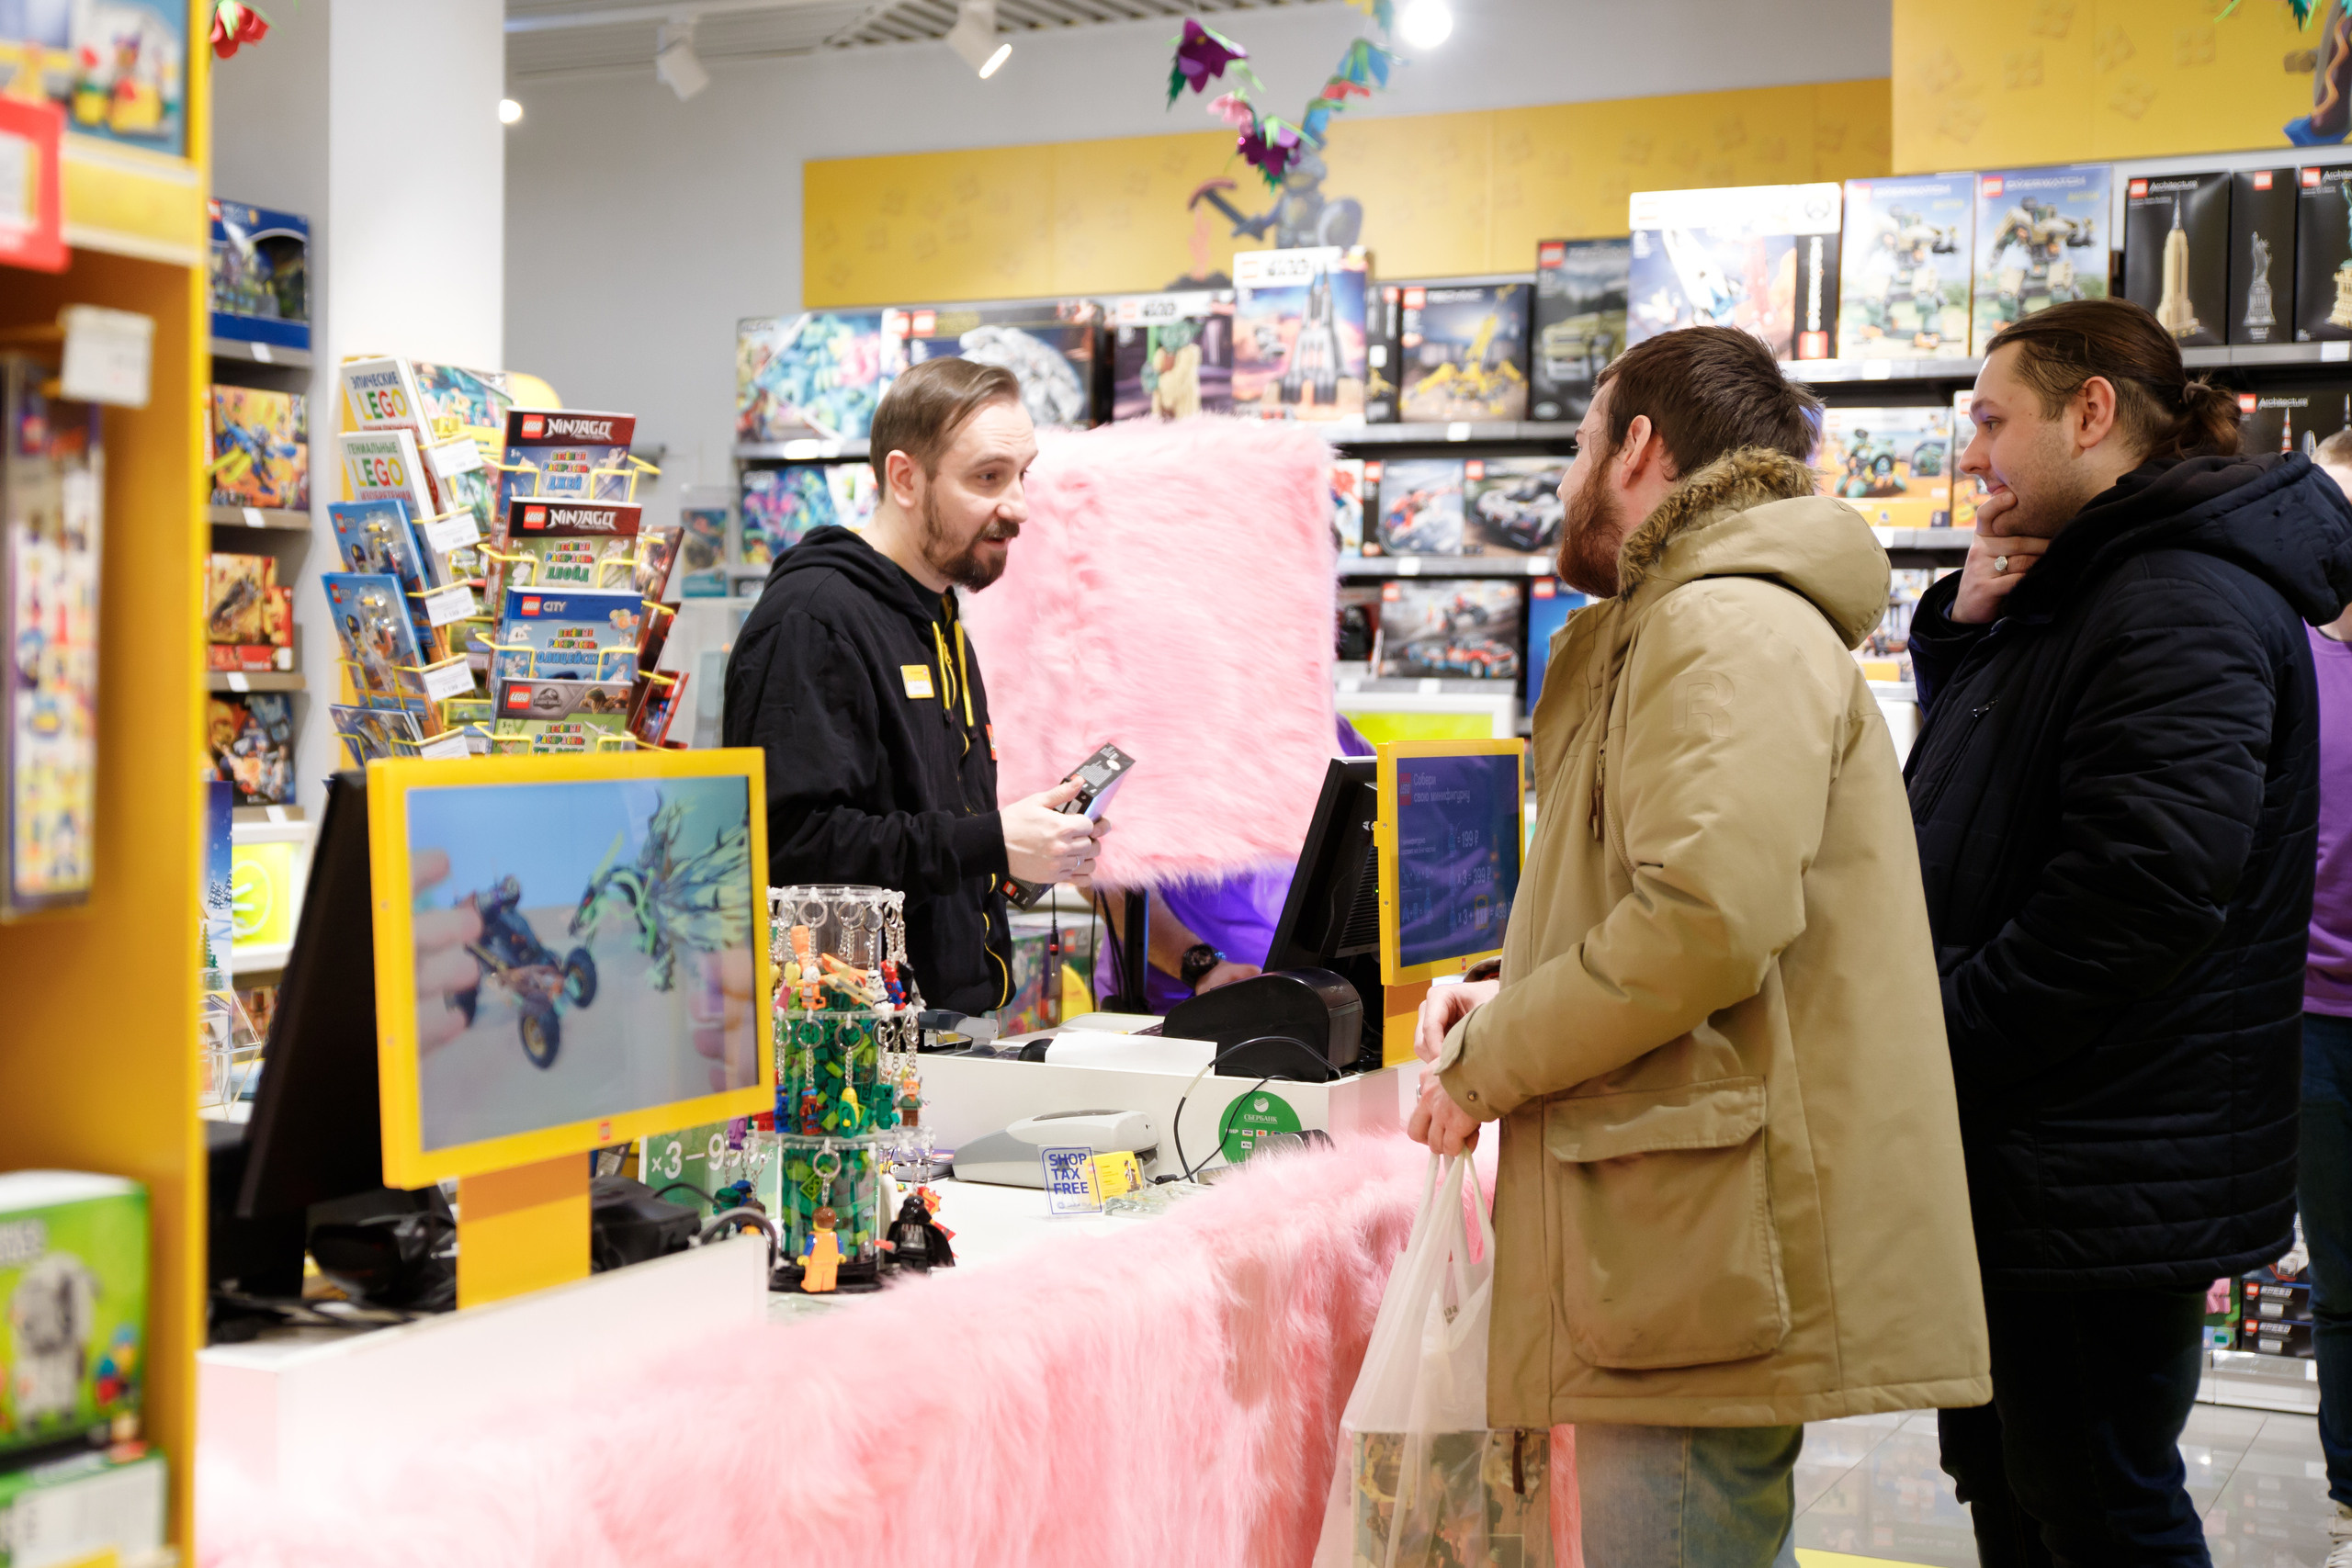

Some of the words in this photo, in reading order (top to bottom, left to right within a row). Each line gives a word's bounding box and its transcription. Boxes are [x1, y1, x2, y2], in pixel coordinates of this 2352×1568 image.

[2148, 179, 2199, 194] Architecture
[350, 371, 399, 389] ЭПИЧЕСКИЕ
[356, 389, 407, 422] LEGO
[2257, 397, 2309, 411] Architecture
[523, 421, 543, 433] LEGO
[543, 418, 614, 441] NINJAGO
[346, 442, 398, 456] ГЕНИАЛЬНЫЕ
[351, 457, 404, 488] LEGO
[547, 475, 582, 491] ДЖЕЙ
[526, 511, 546, 523] LEGO
[546, 509, 617, 531] NINJAGO
[545, 565, 590, 582] ЛЛОЙД
[523, 602, 540, 611] LEGO
[543, 601, 567, 613] CITY
[510, 692, 530, 702] LEGO
[1413, 772, 1437, 788] Собери
[1414, 792, 1430, 803] свою
[1462, 829, 1474, 848] 199
[1243, 1113, 1278, 1123] СБЕРБАНК
[1048, 1153, 1087, 1166] SHOP
[1051, 1168, 1080, 1180] TAX
[1053, 1181, 1090, 1195] FREE
